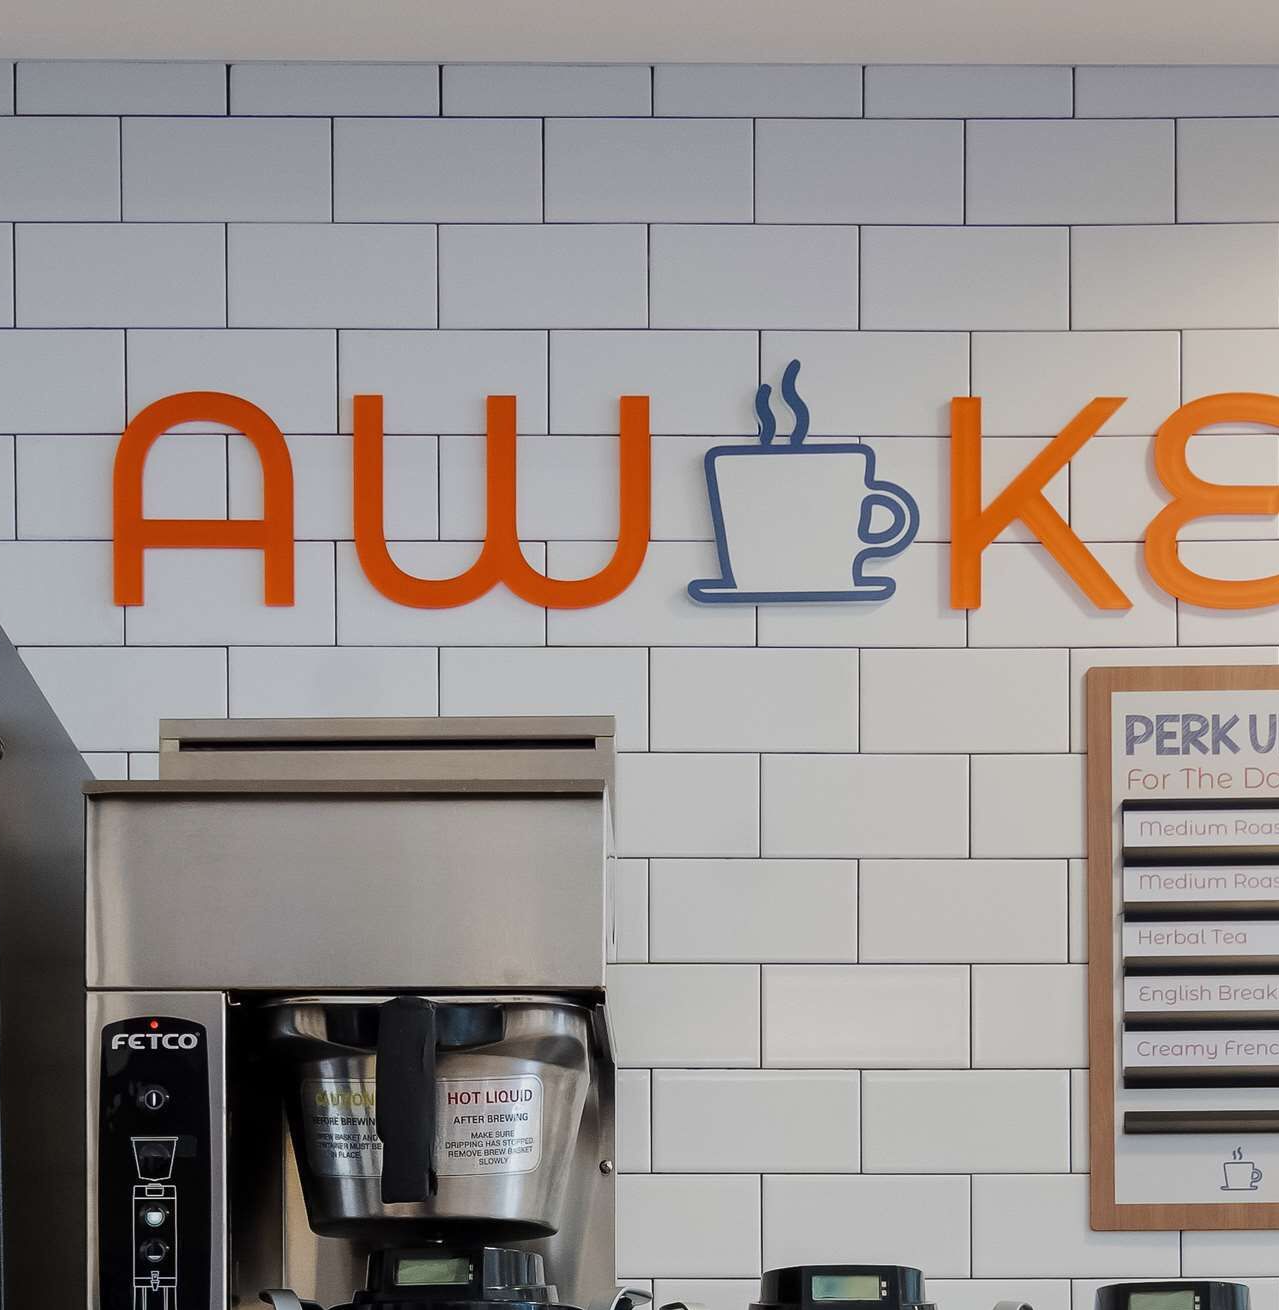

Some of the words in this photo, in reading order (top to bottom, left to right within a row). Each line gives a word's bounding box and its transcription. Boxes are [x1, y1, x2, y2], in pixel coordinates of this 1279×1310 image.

[1125, 713, 1241, 756] PERK
[1127, 769, 1171, 791] For
[1180, 767, 1233, 790] The
[1140, 820, 1228, 837] Medium
[1139, 873, 1227, 890] Medium
[1138, 929, 1207, 945] Herbal
[1212, 928, 1247, 945] Tea
[1138, 985, 1211, 1005] English
[111, 1033, 198, 1050] FETCO
[1136, 1041, 1218, 1060] Creamy
[448, 1091, 480, 1105] HOT
[486, 1088, 533, 1104] LIQUID
[341, 1117, 376, 1126] BREWIN
[453, 1115, 484, 1125] AFTER
[487, 1112, 529, 1123] BREWING
[445, 1141, 483, 1149] DRIPPING
[485, 1139, 500, 1147] HAS
[448, 1149, 482, 1157] REMOVE
[484, 1148, 505, 1156] BREW
